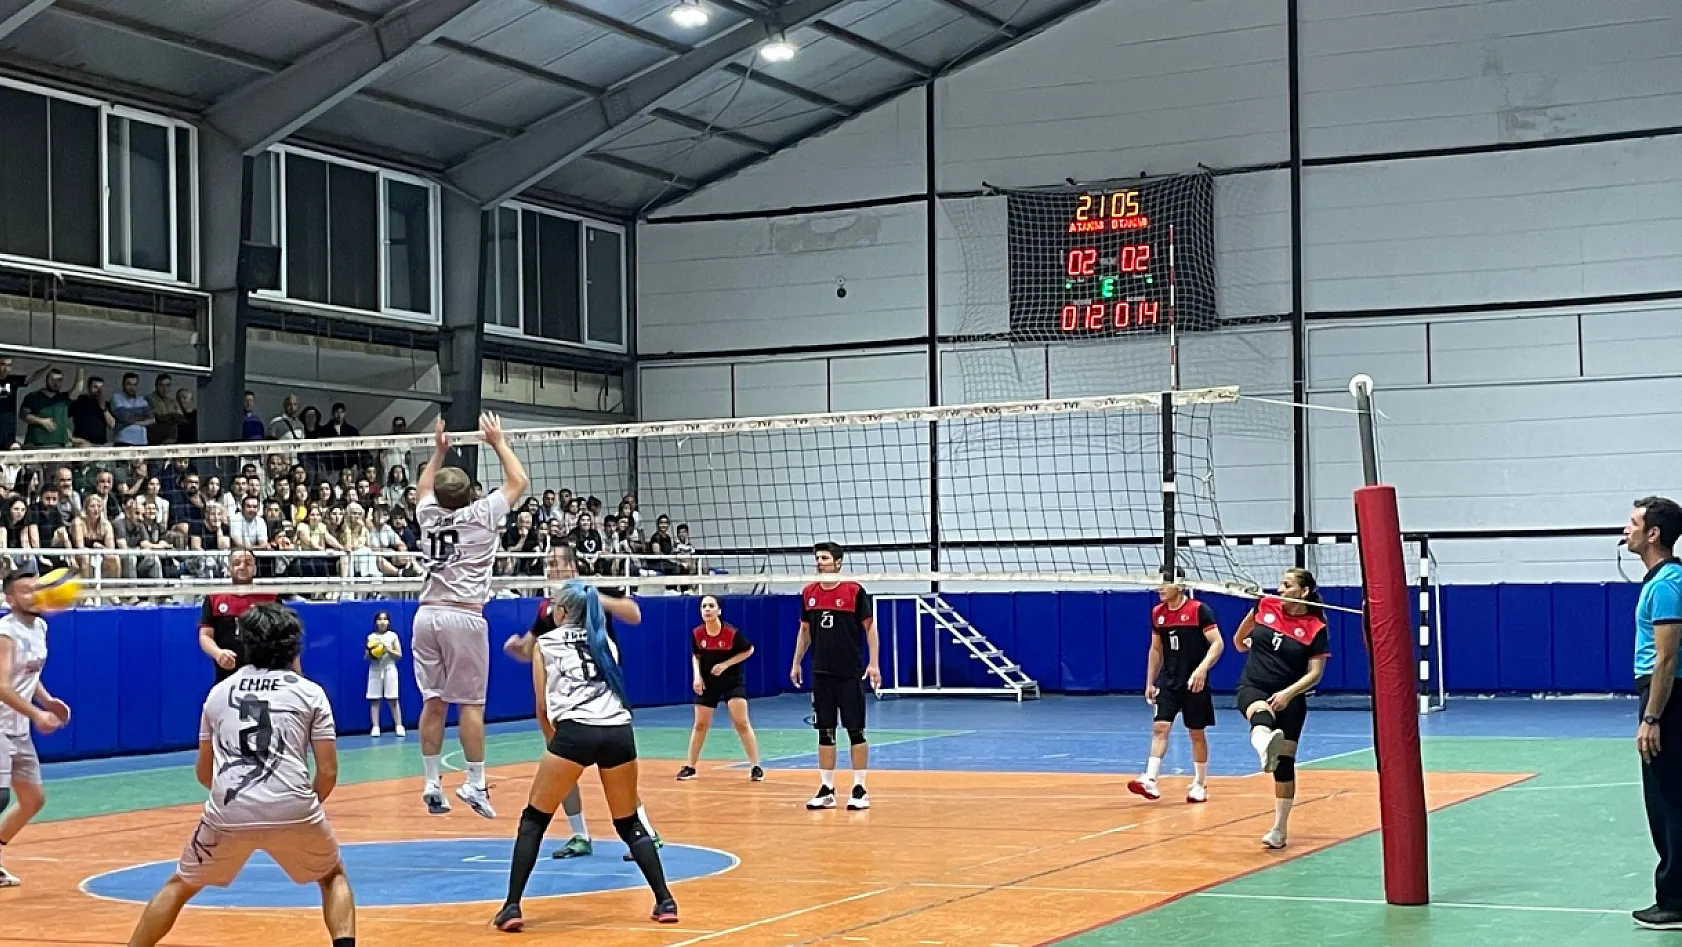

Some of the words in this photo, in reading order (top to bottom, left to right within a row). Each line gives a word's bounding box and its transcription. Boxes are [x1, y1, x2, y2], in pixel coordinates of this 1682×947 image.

[1068, 250, 1097, 275] 02
[1122, 245, 1150, 272] 02
[239, 678, 281, 691] EMRE
